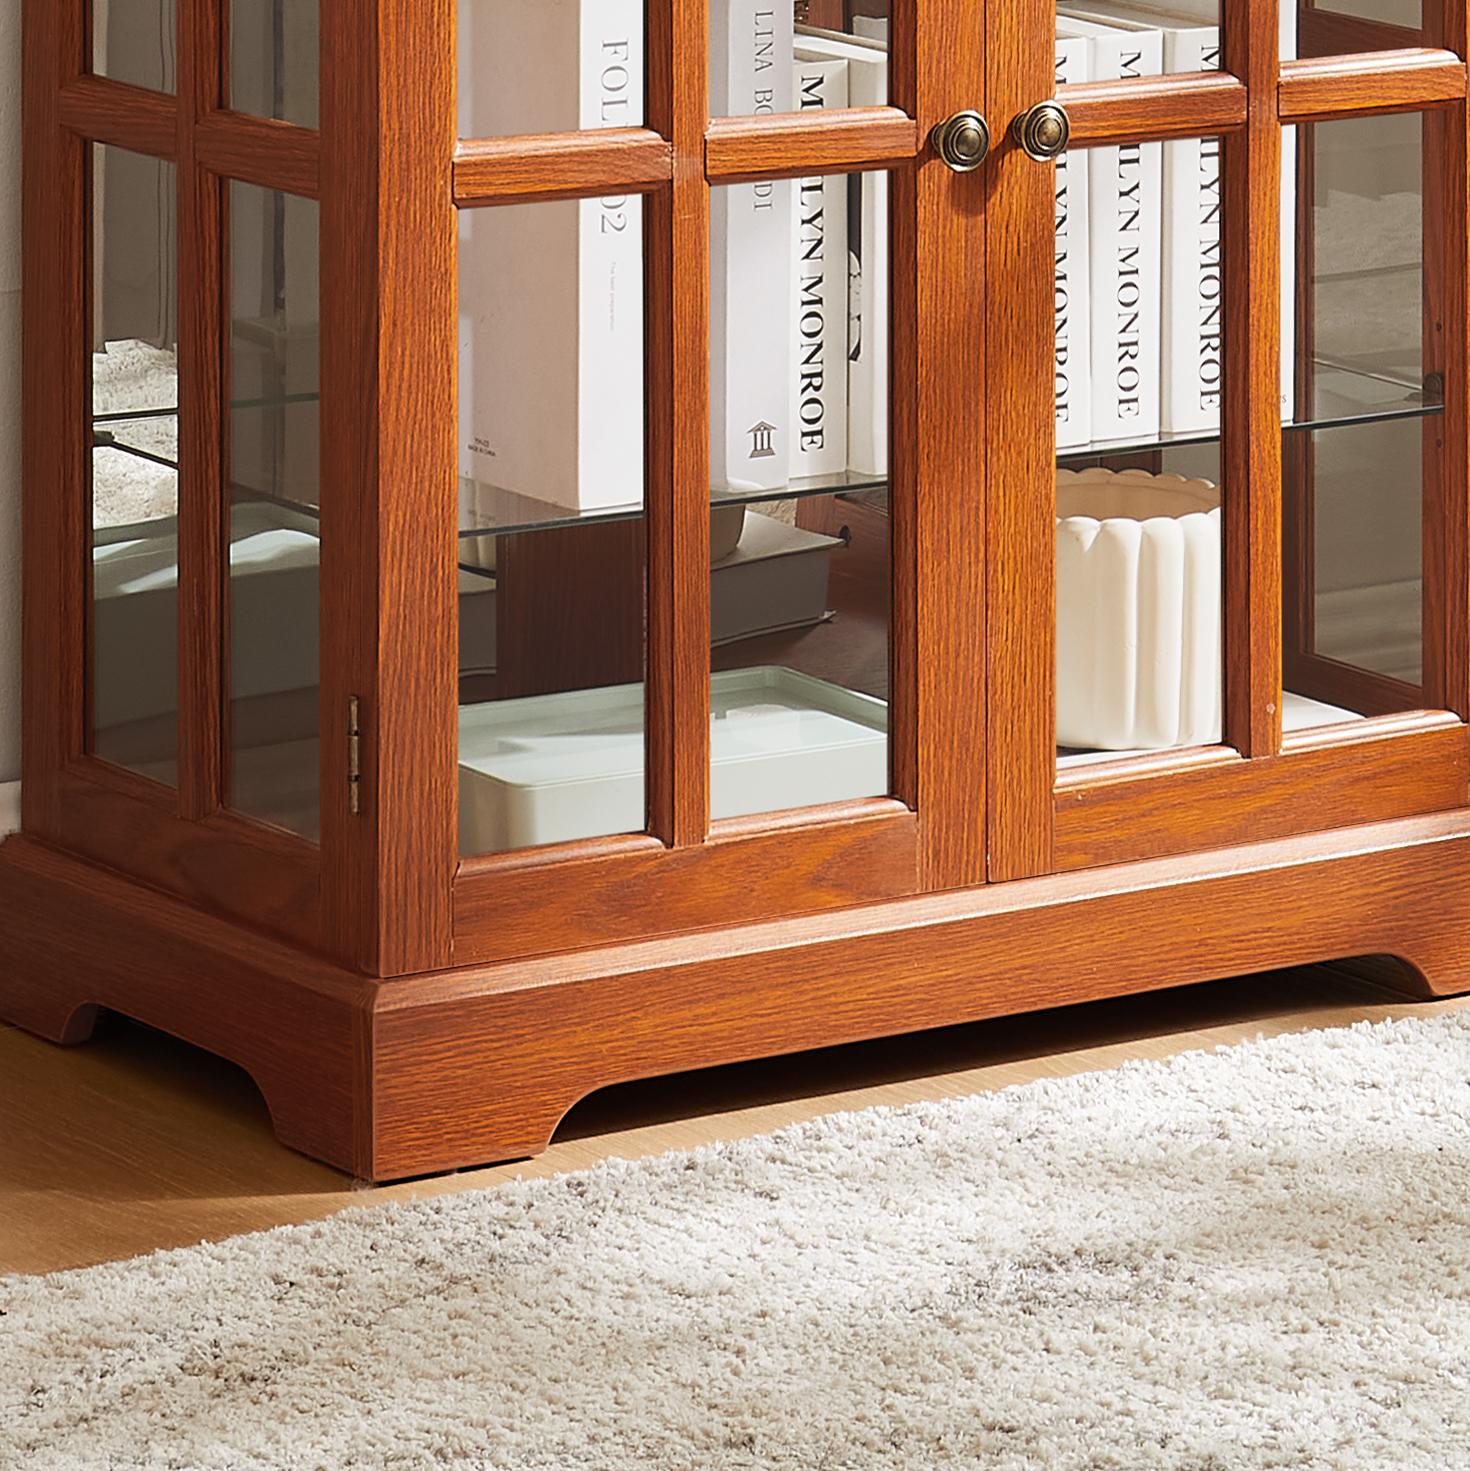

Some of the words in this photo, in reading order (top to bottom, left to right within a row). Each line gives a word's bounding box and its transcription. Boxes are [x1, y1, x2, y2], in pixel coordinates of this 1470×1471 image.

[754, 10, 774, 73] LINA
[799, 272, 825, 452] MONROE
[1117, 244, 1140, 420] MONROE
